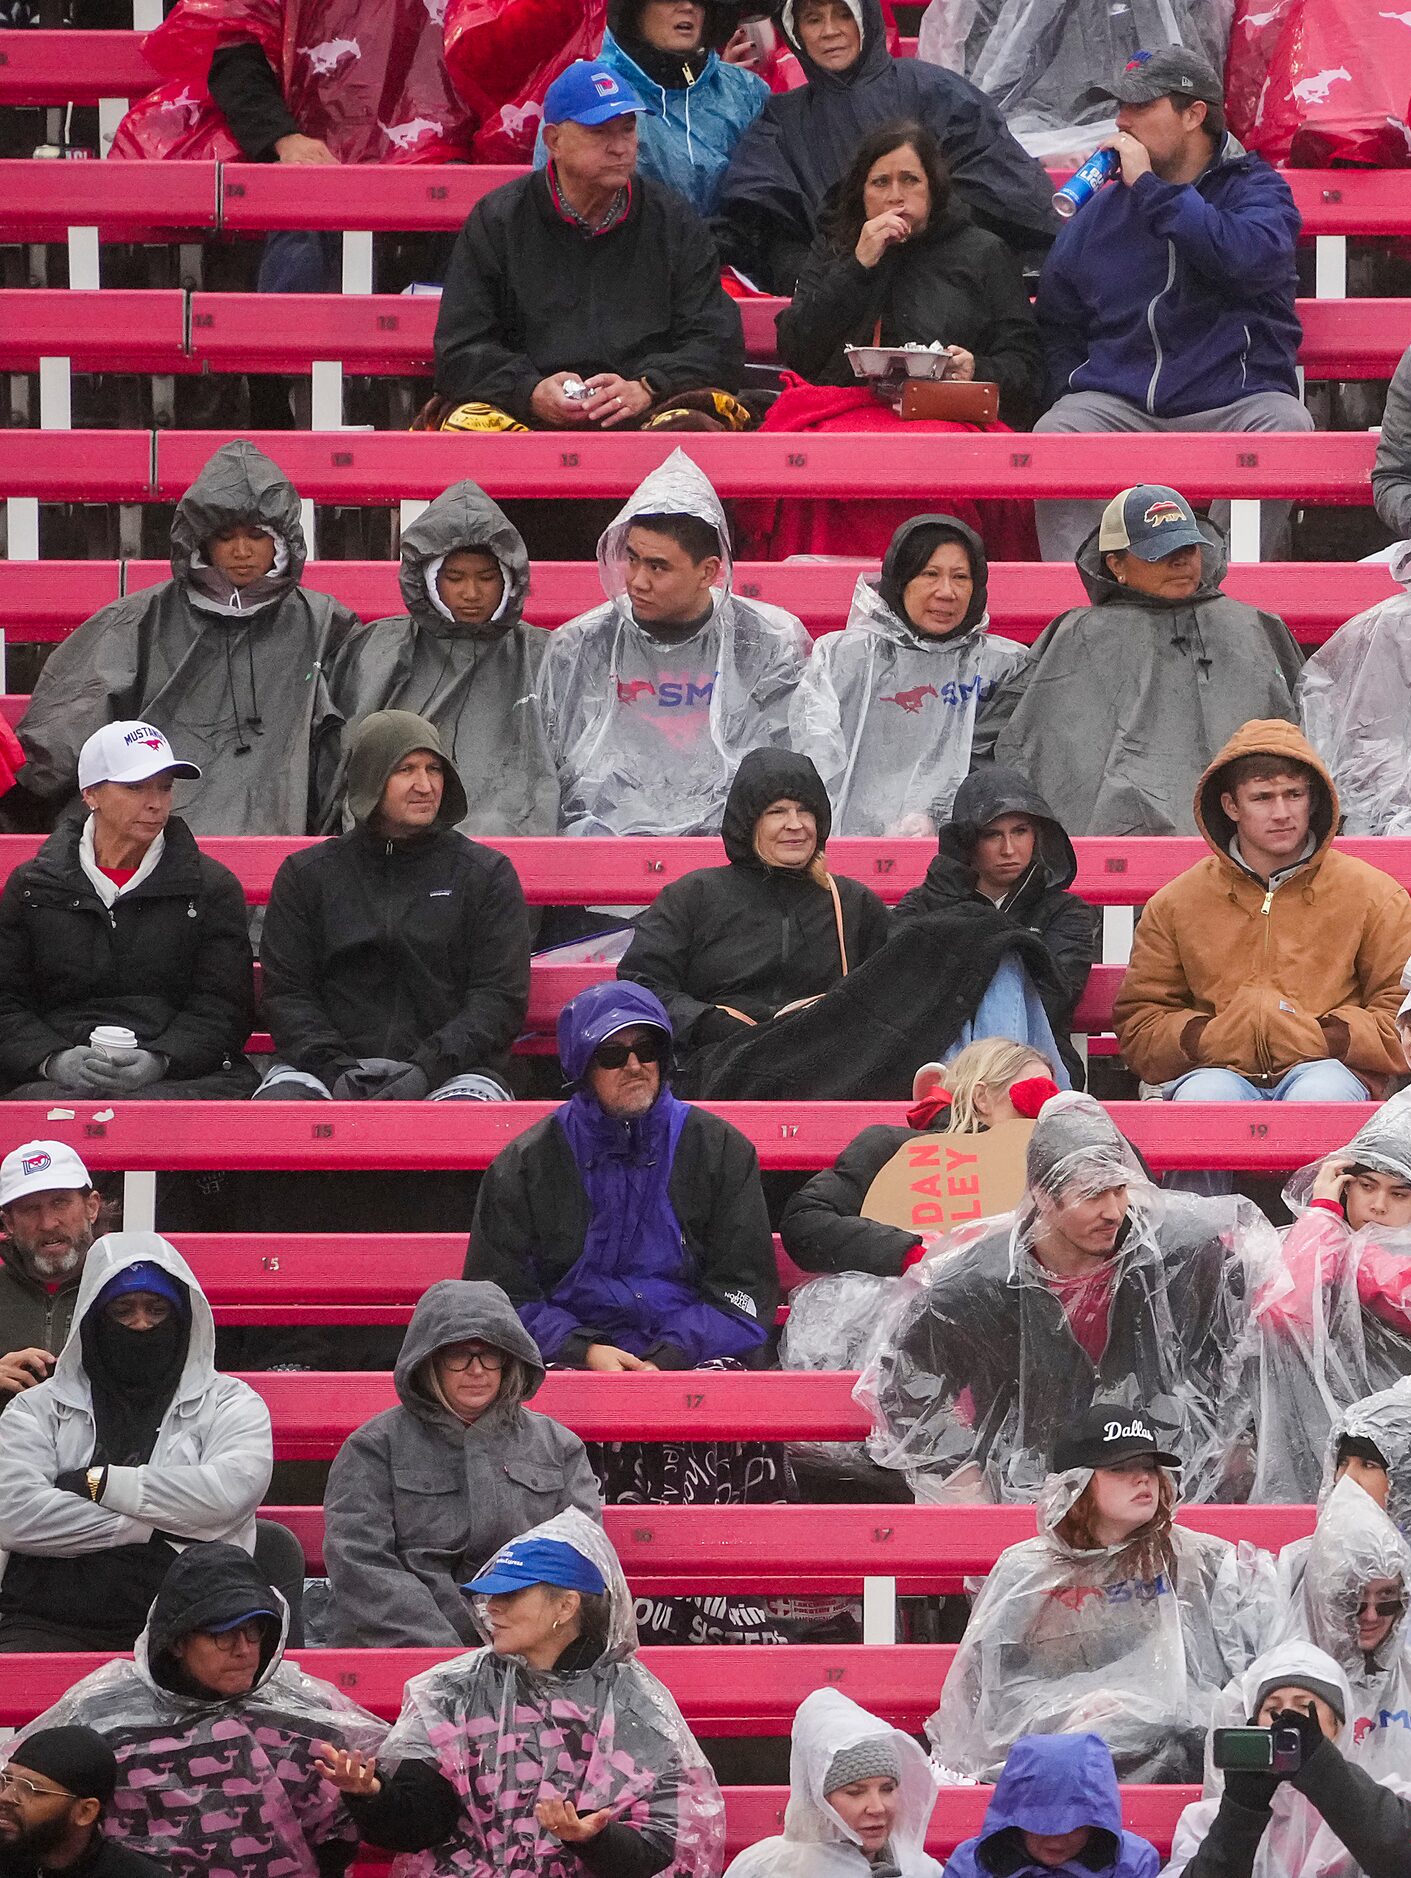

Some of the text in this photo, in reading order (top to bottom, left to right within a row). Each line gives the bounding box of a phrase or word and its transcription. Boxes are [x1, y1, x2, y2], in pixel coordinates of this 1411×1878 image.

[561, 453, 580, 467] 15
[786, 454, 805, 467] 16
[1011, 454, 1031, 467] 17
[658, 683, 715, 708] SM
[877, 859, 894, 873] 17
[780, 1125, 799, 1137] 17
[1249, 1124, 1267, 1138] 19
[262, 1257, 280, 1270] 15
[686, 1395, 704, 1409] 17
[1103, 1419, 1154, 1441] Dallas
[875, 1528, 893, 1541] 17
[633, 1598, 677, 1634] OUL
[826, 1669, 845, 1682] 17
